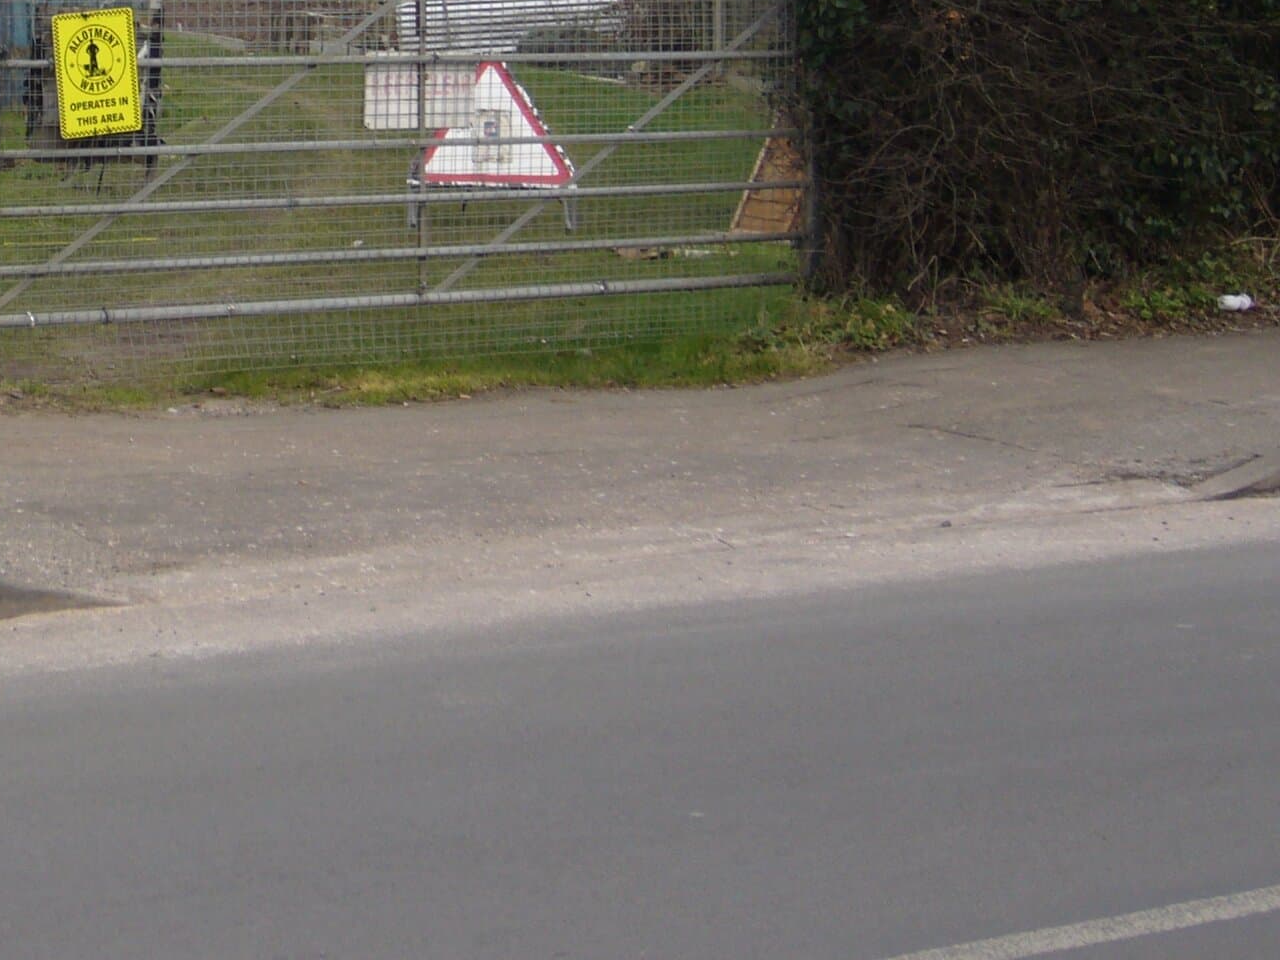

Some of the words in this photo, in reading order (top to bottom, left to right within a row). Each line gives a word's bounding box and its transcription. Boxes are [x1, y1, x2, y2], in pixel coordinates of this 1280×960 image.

[69, 27, 120, 54] ALLOTMENT
[80, 75, 115, 92] WATCH
[70, 98, 117, 112] OPERATES
[119, 96, 129, 105] IN
[76, 116, 98, 126] THIS
[100, 113, 125, 124] AREA
